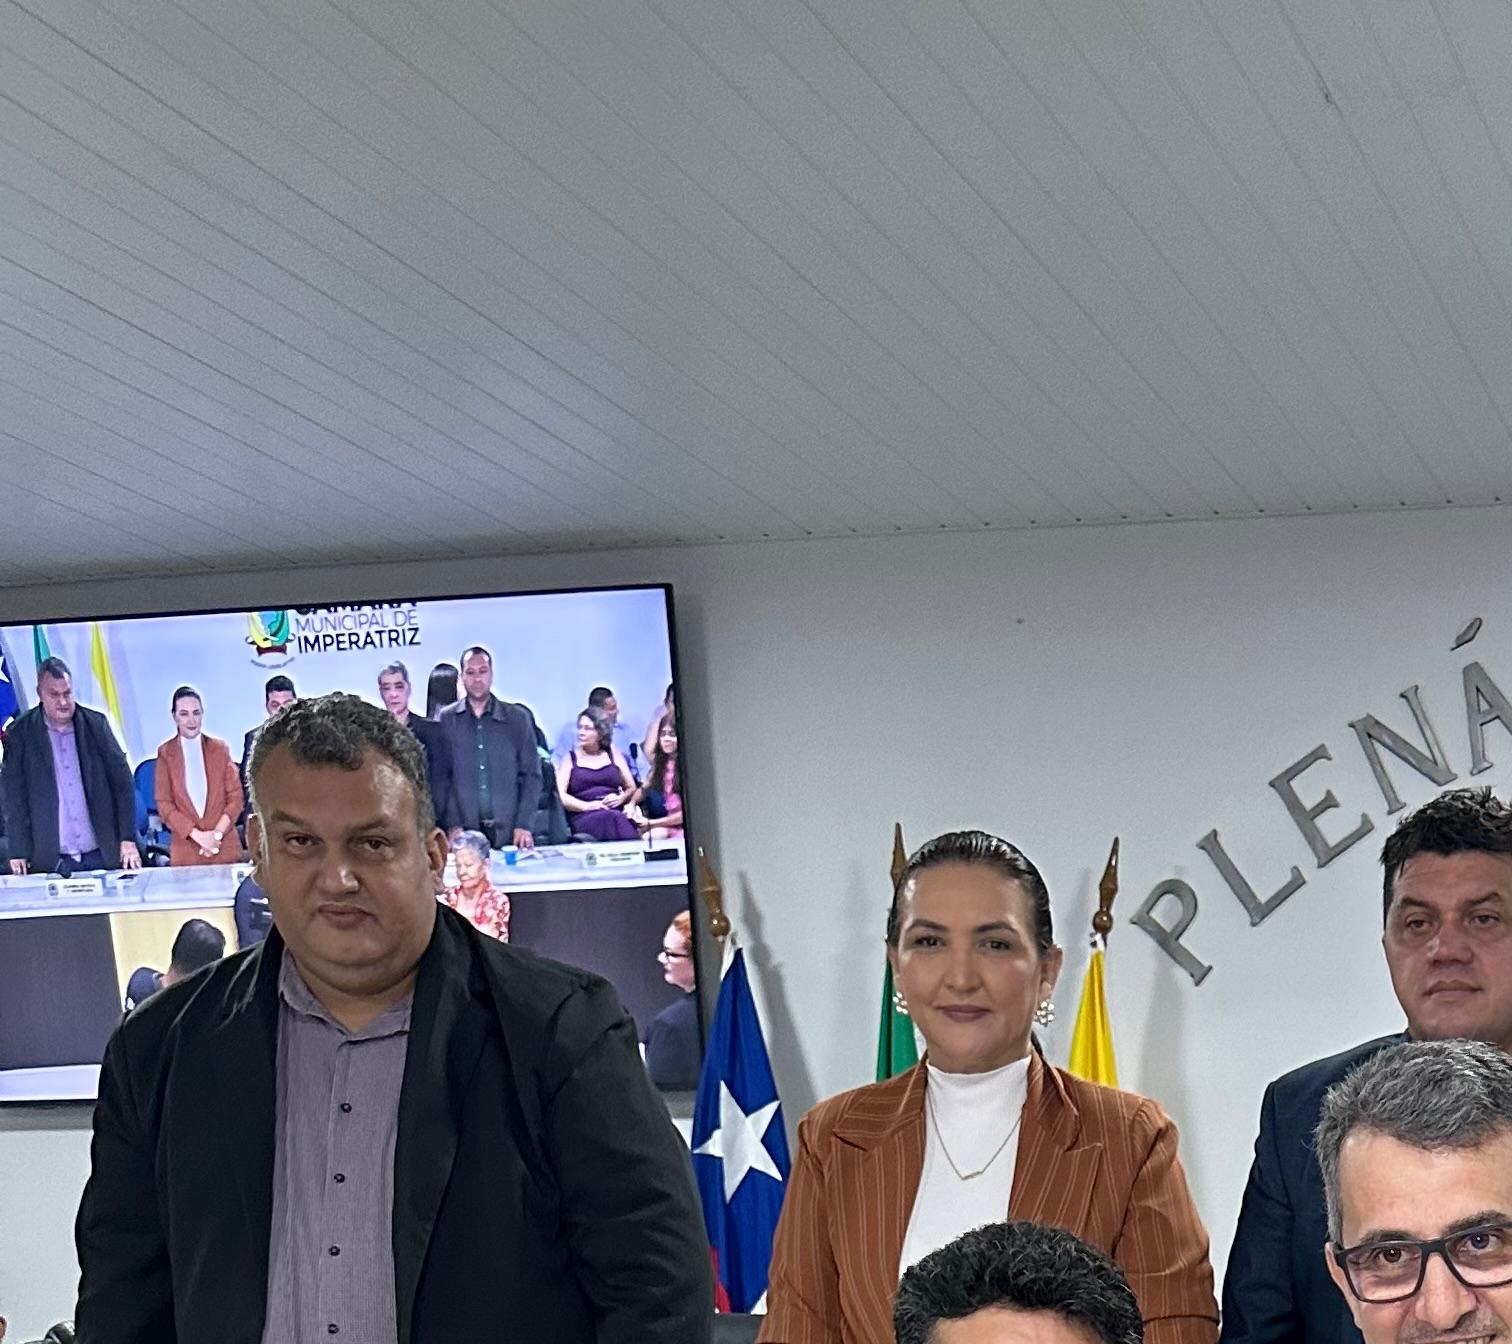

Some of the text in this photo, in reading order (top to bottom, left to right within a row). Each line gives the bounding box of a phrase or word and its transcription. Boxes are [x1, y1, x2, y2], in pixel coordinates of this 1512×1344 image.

[295, 609, 418, 634] MUNICIPAL DE
[297, 627, 422, 654] IMPERATRIZ
